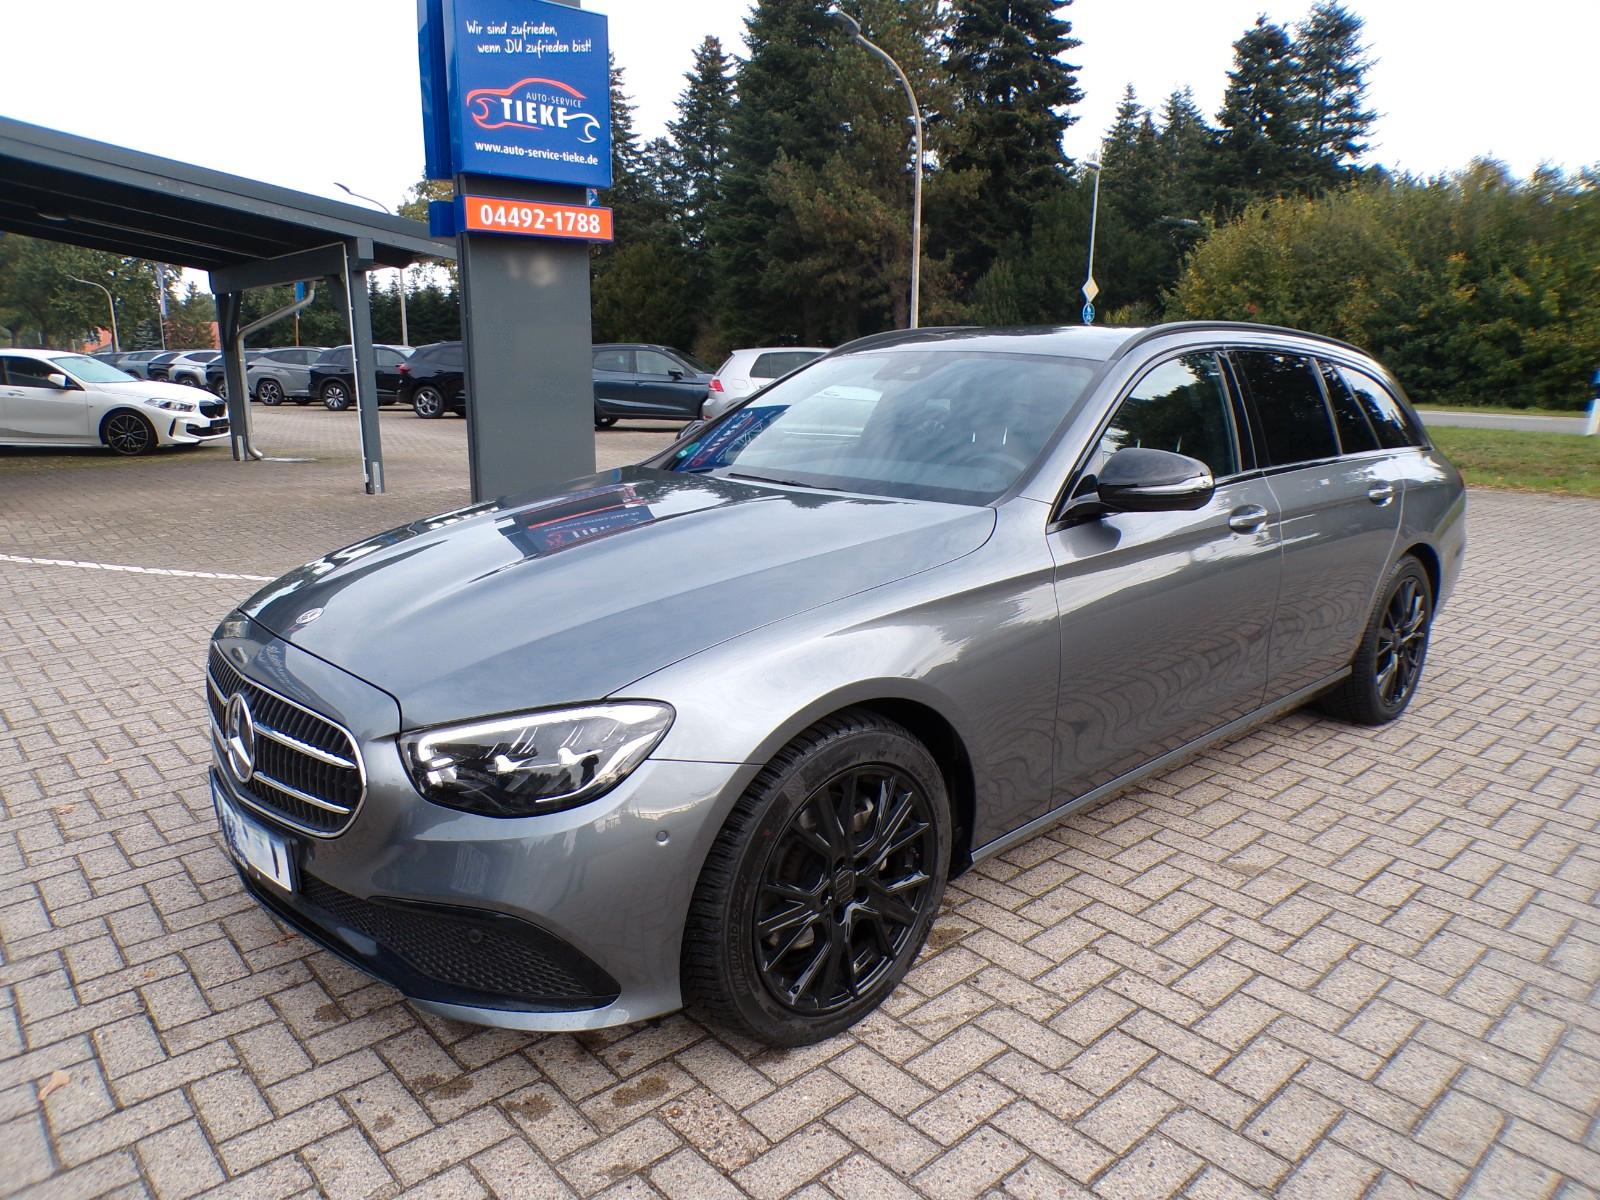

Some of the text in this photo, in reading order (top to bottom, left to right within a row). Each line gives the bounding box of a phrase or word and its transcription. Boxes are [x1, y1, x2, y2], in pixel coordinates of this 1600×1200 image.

[466, 20, 558, 41] Wir sind zufrieden,
[477, 38, 592, 59] wenn DU zufrieden bist!
[526, 91, 582, 109] AUTO-SERVICE
[500, 97, 568, 129] TIEKE
[474, 141, 599, 166] www.auto-service-tieke.de
[480, 204, 601, 234] 04492-1788
